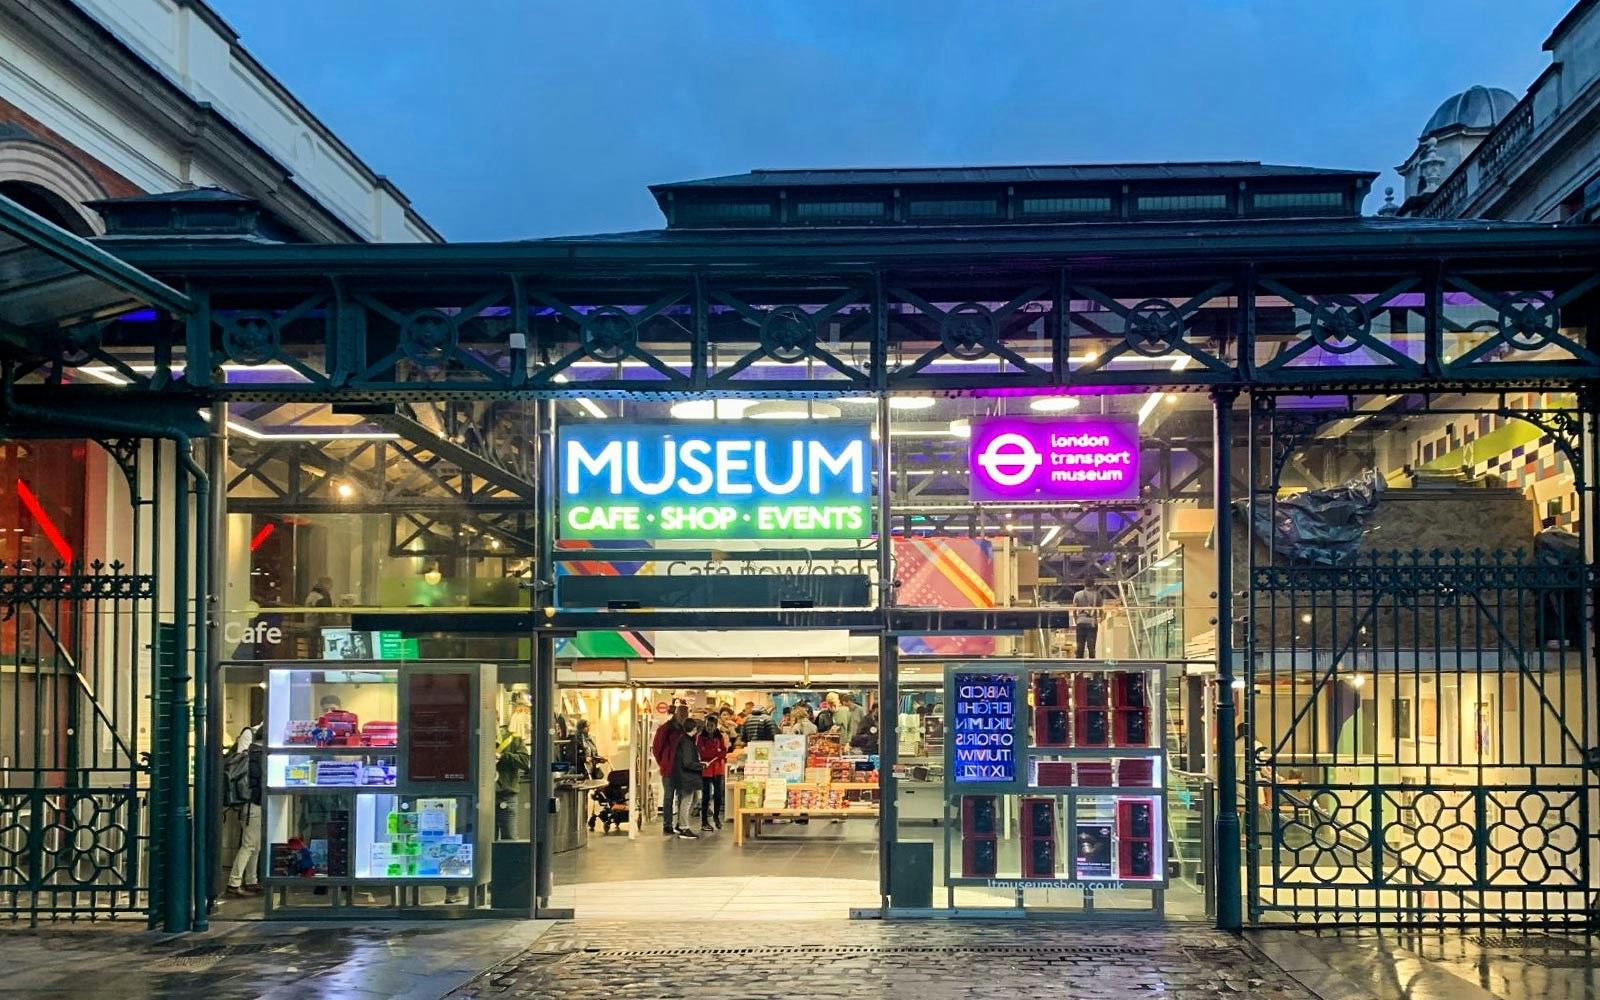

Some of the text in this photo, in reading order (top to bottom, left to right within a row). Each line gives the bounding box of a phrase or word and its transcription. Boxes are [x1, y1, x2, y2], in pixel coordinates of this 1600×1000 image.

[1051, 433, 1109, 448] london
[566, 439, 864, 495] MUSEUM
[1051, 451, 1131, 468] transport
[1051, 469, 1123, 482] museum
[567, 506, 863, 531] CAFE SHOP EVENTS
[224, 620, 283, 645] Cafe
[987, 879, 1124, 891] ltmuseumshop.co.uk
